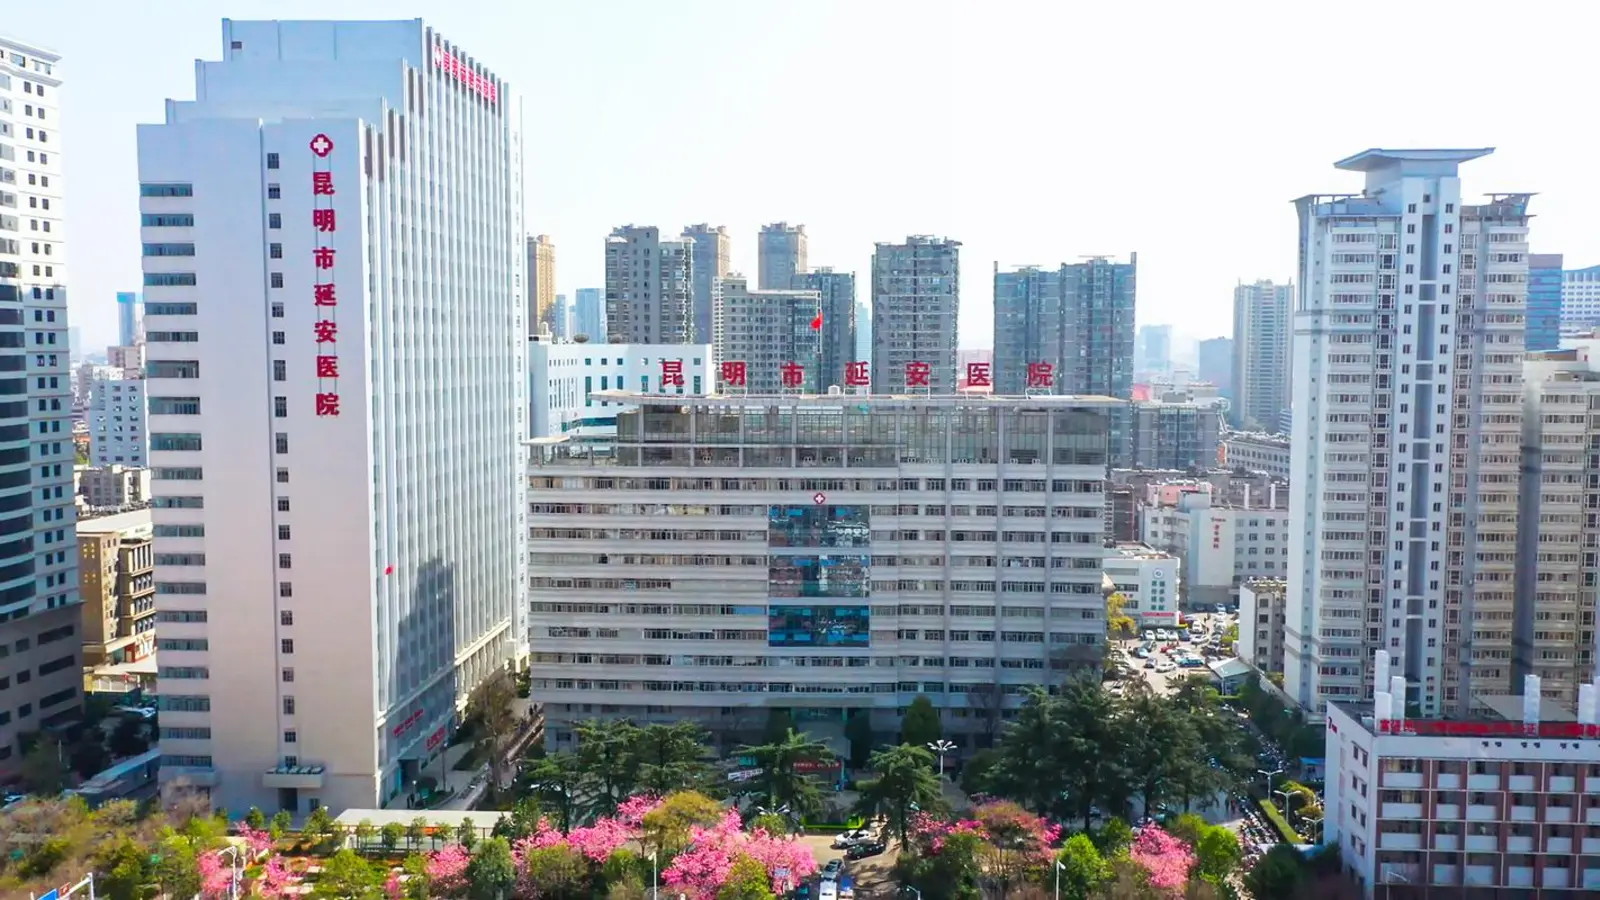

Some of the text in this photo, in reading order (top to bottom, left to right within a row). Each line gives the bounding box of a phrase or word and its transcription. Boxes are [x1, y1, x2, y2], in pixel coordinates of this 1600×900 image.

[312, 171, 340, 417] 昆明市延安医院
[662, 360, 1053, 388] 昆明市延安医院
